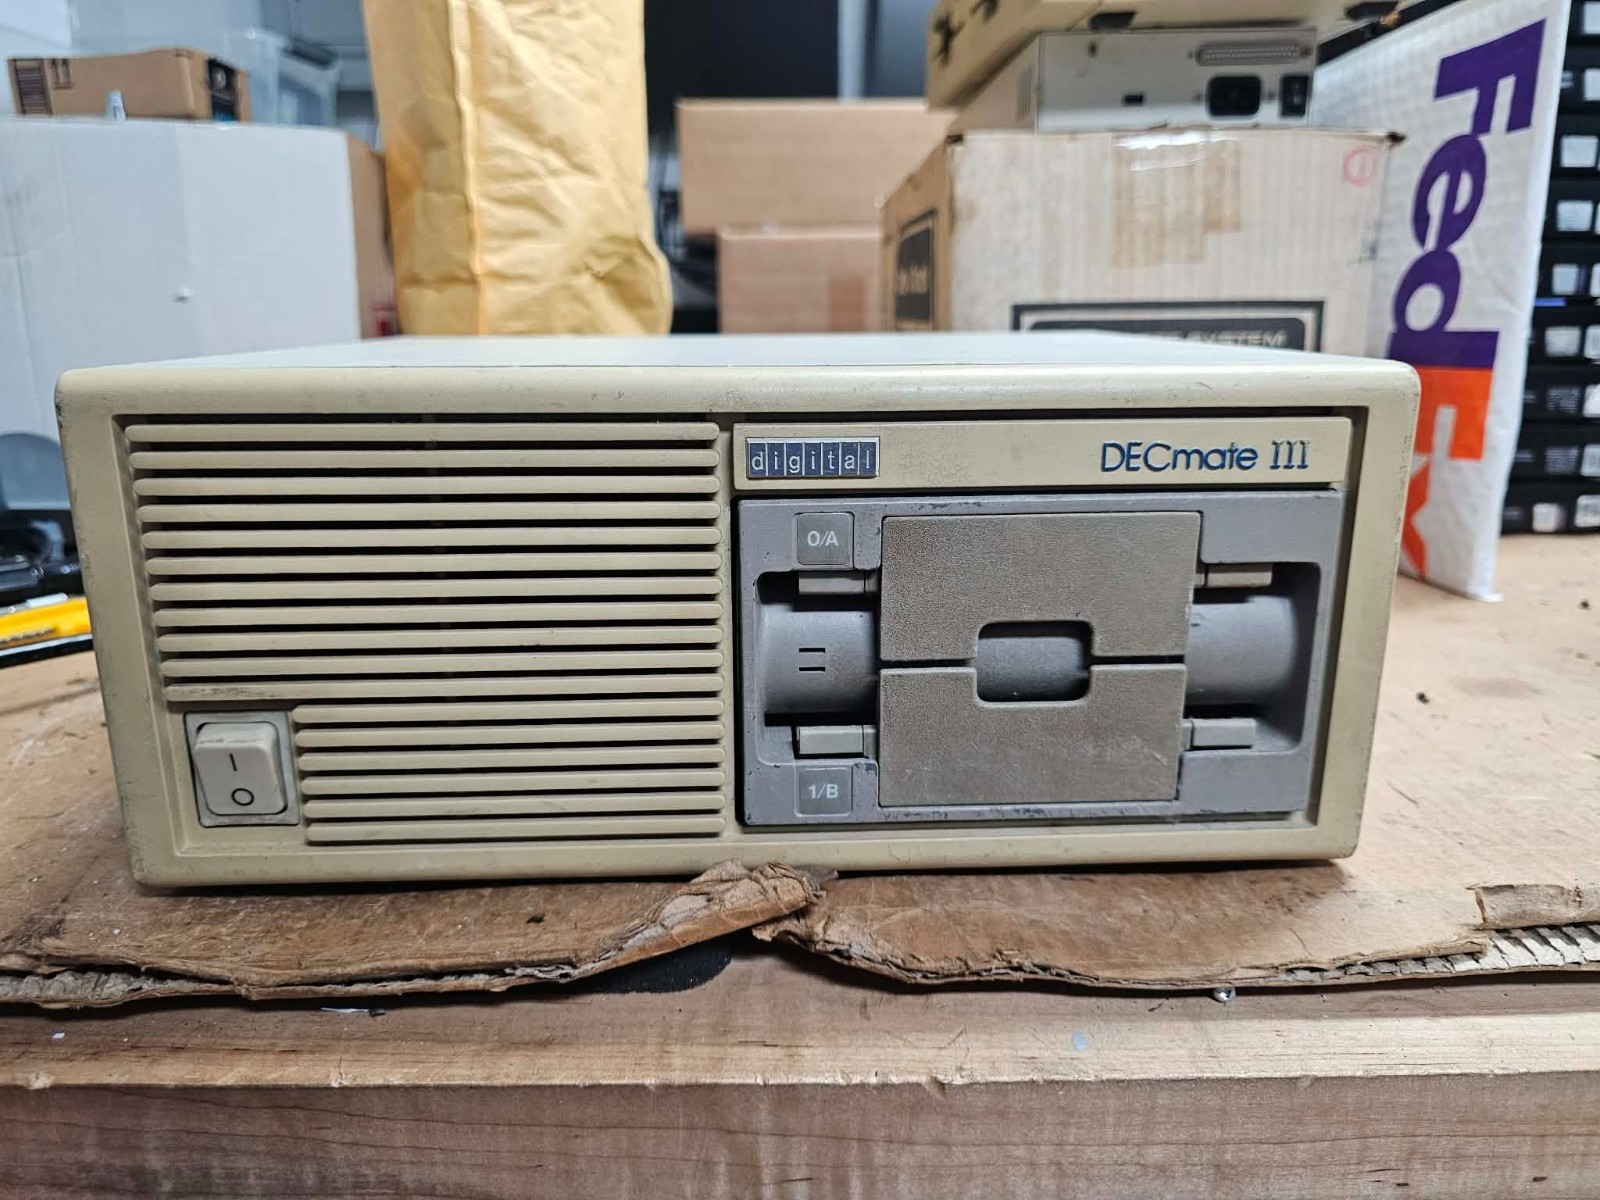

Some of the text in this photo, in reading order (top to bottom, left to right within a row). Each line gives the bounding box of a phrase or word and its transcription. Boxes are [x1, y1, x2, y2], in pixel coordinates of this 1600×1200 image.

[751, 449, 870, 474] digital
[1100, 438, 1310, 472] DECmate III
[808, 783, 839, 799] 1/B
